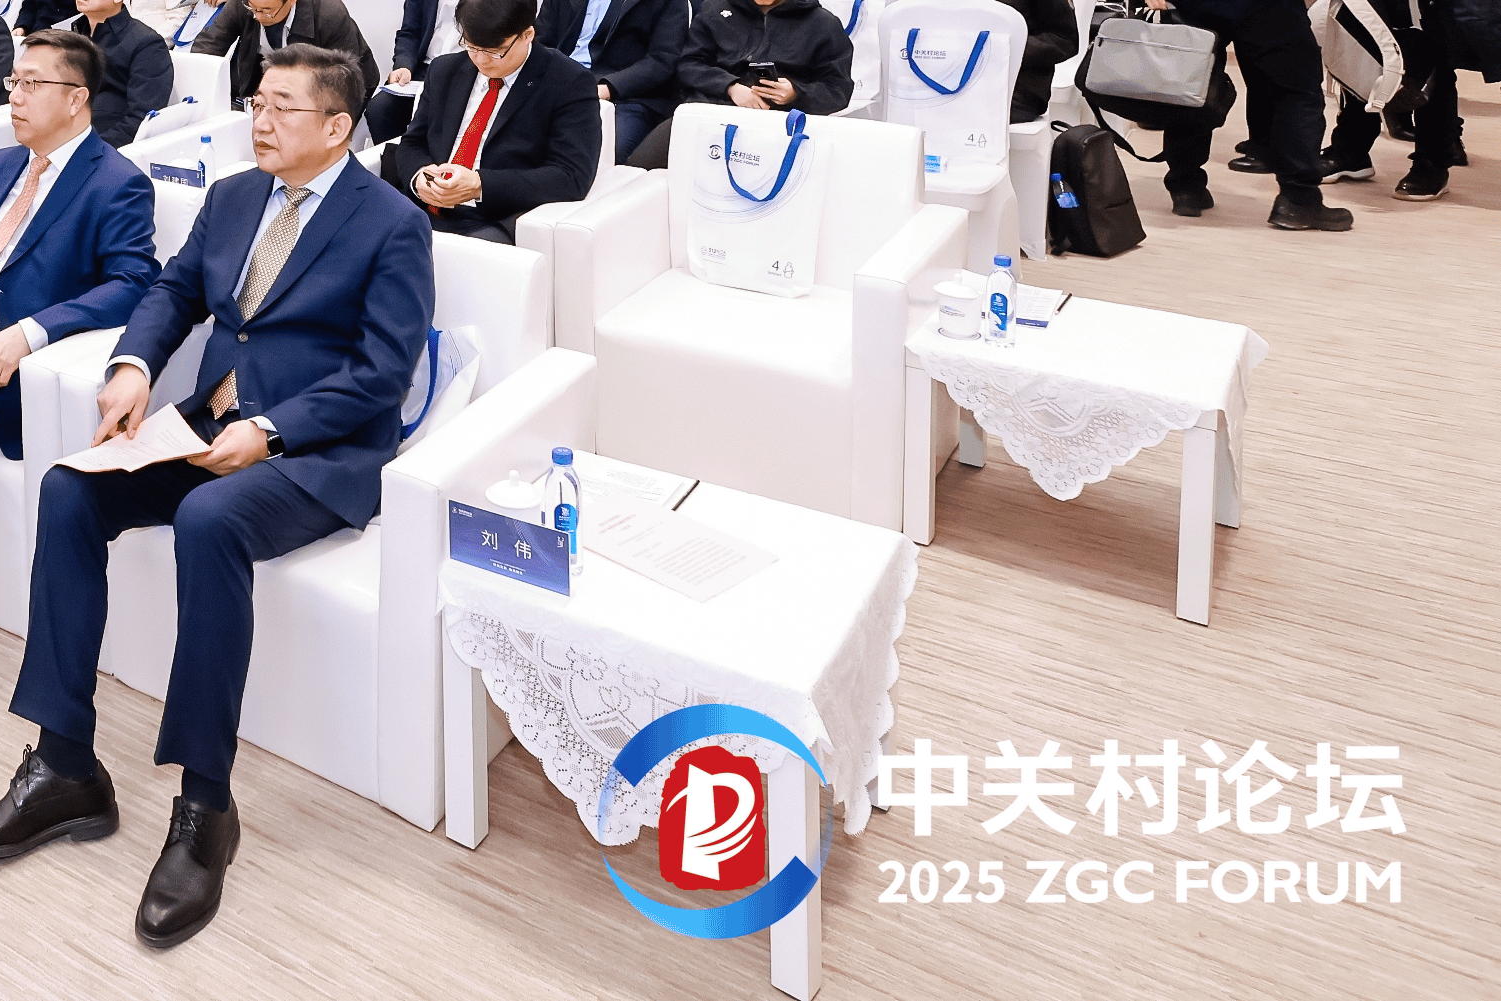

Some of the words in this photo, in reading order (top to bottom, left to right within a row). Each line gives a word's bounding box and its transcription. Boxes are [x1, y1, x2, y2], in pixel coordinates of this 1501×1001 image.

[967, 133, 975, 143] 4
[731, 150, 761, 163] 关村论坛
[771, 260, 780, 272] 4
[480, 529, 532, 560] 刘伟
